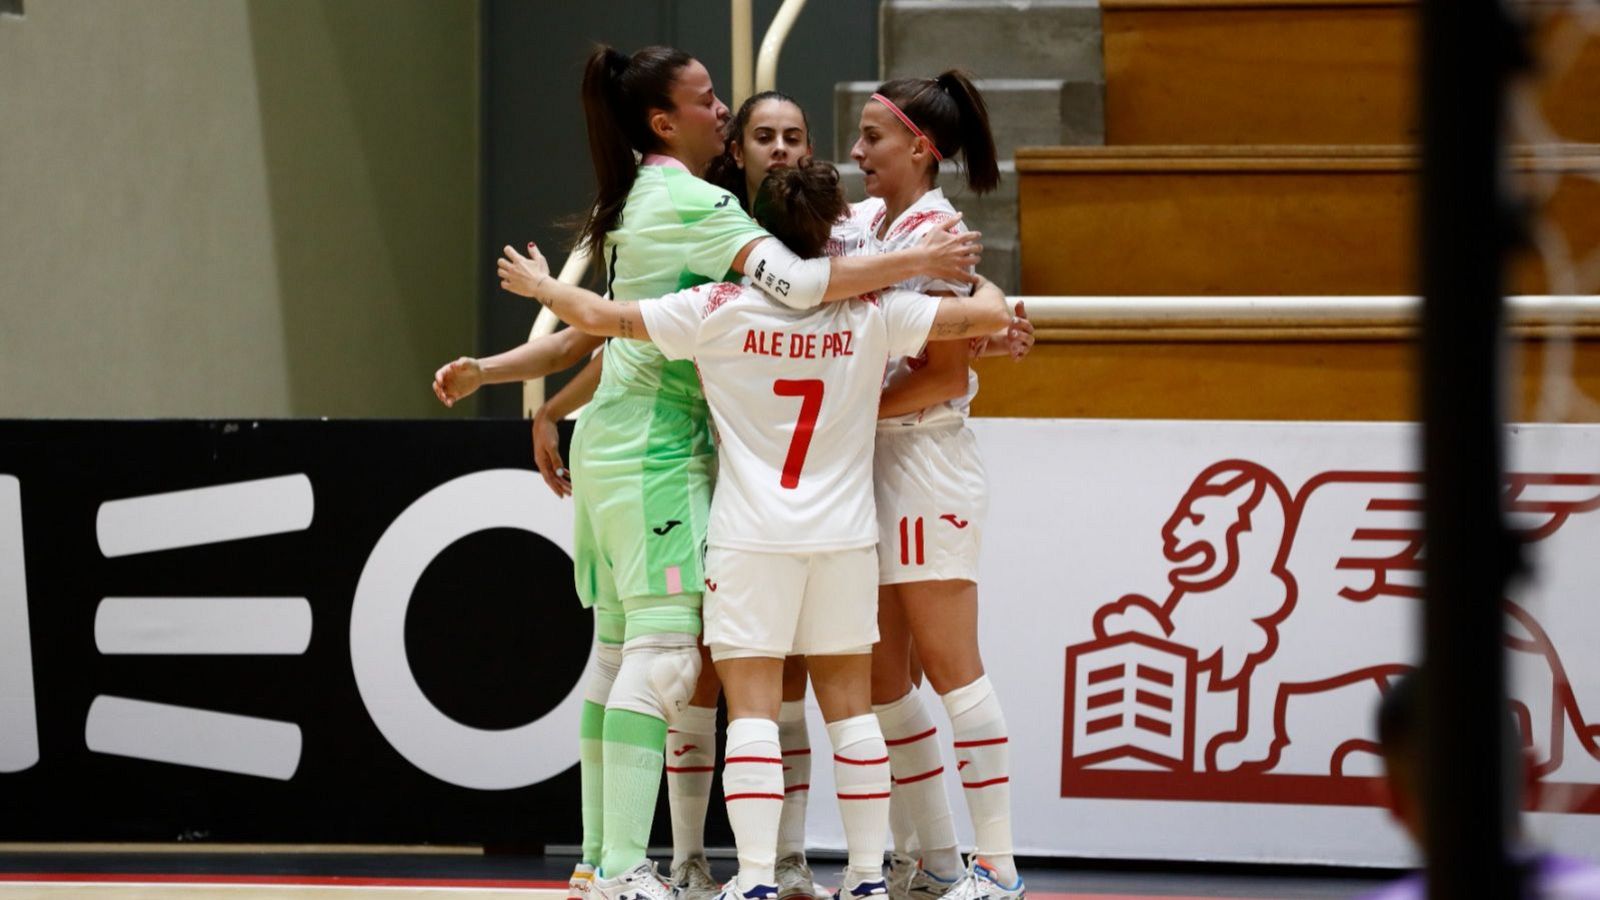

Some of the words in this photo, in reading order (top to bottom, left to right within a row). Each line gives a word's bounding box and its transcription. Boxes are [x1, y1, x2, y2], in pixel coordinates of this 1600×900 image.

[775, 278, 791, 297] 23
[743, 329, 784, 357] ALE
[789, 333, 817, 359] DE
[821, 330, 854, 358] PAZ
[773, 378, 825, 490] 7
[899, 516, 925, 566] 11
